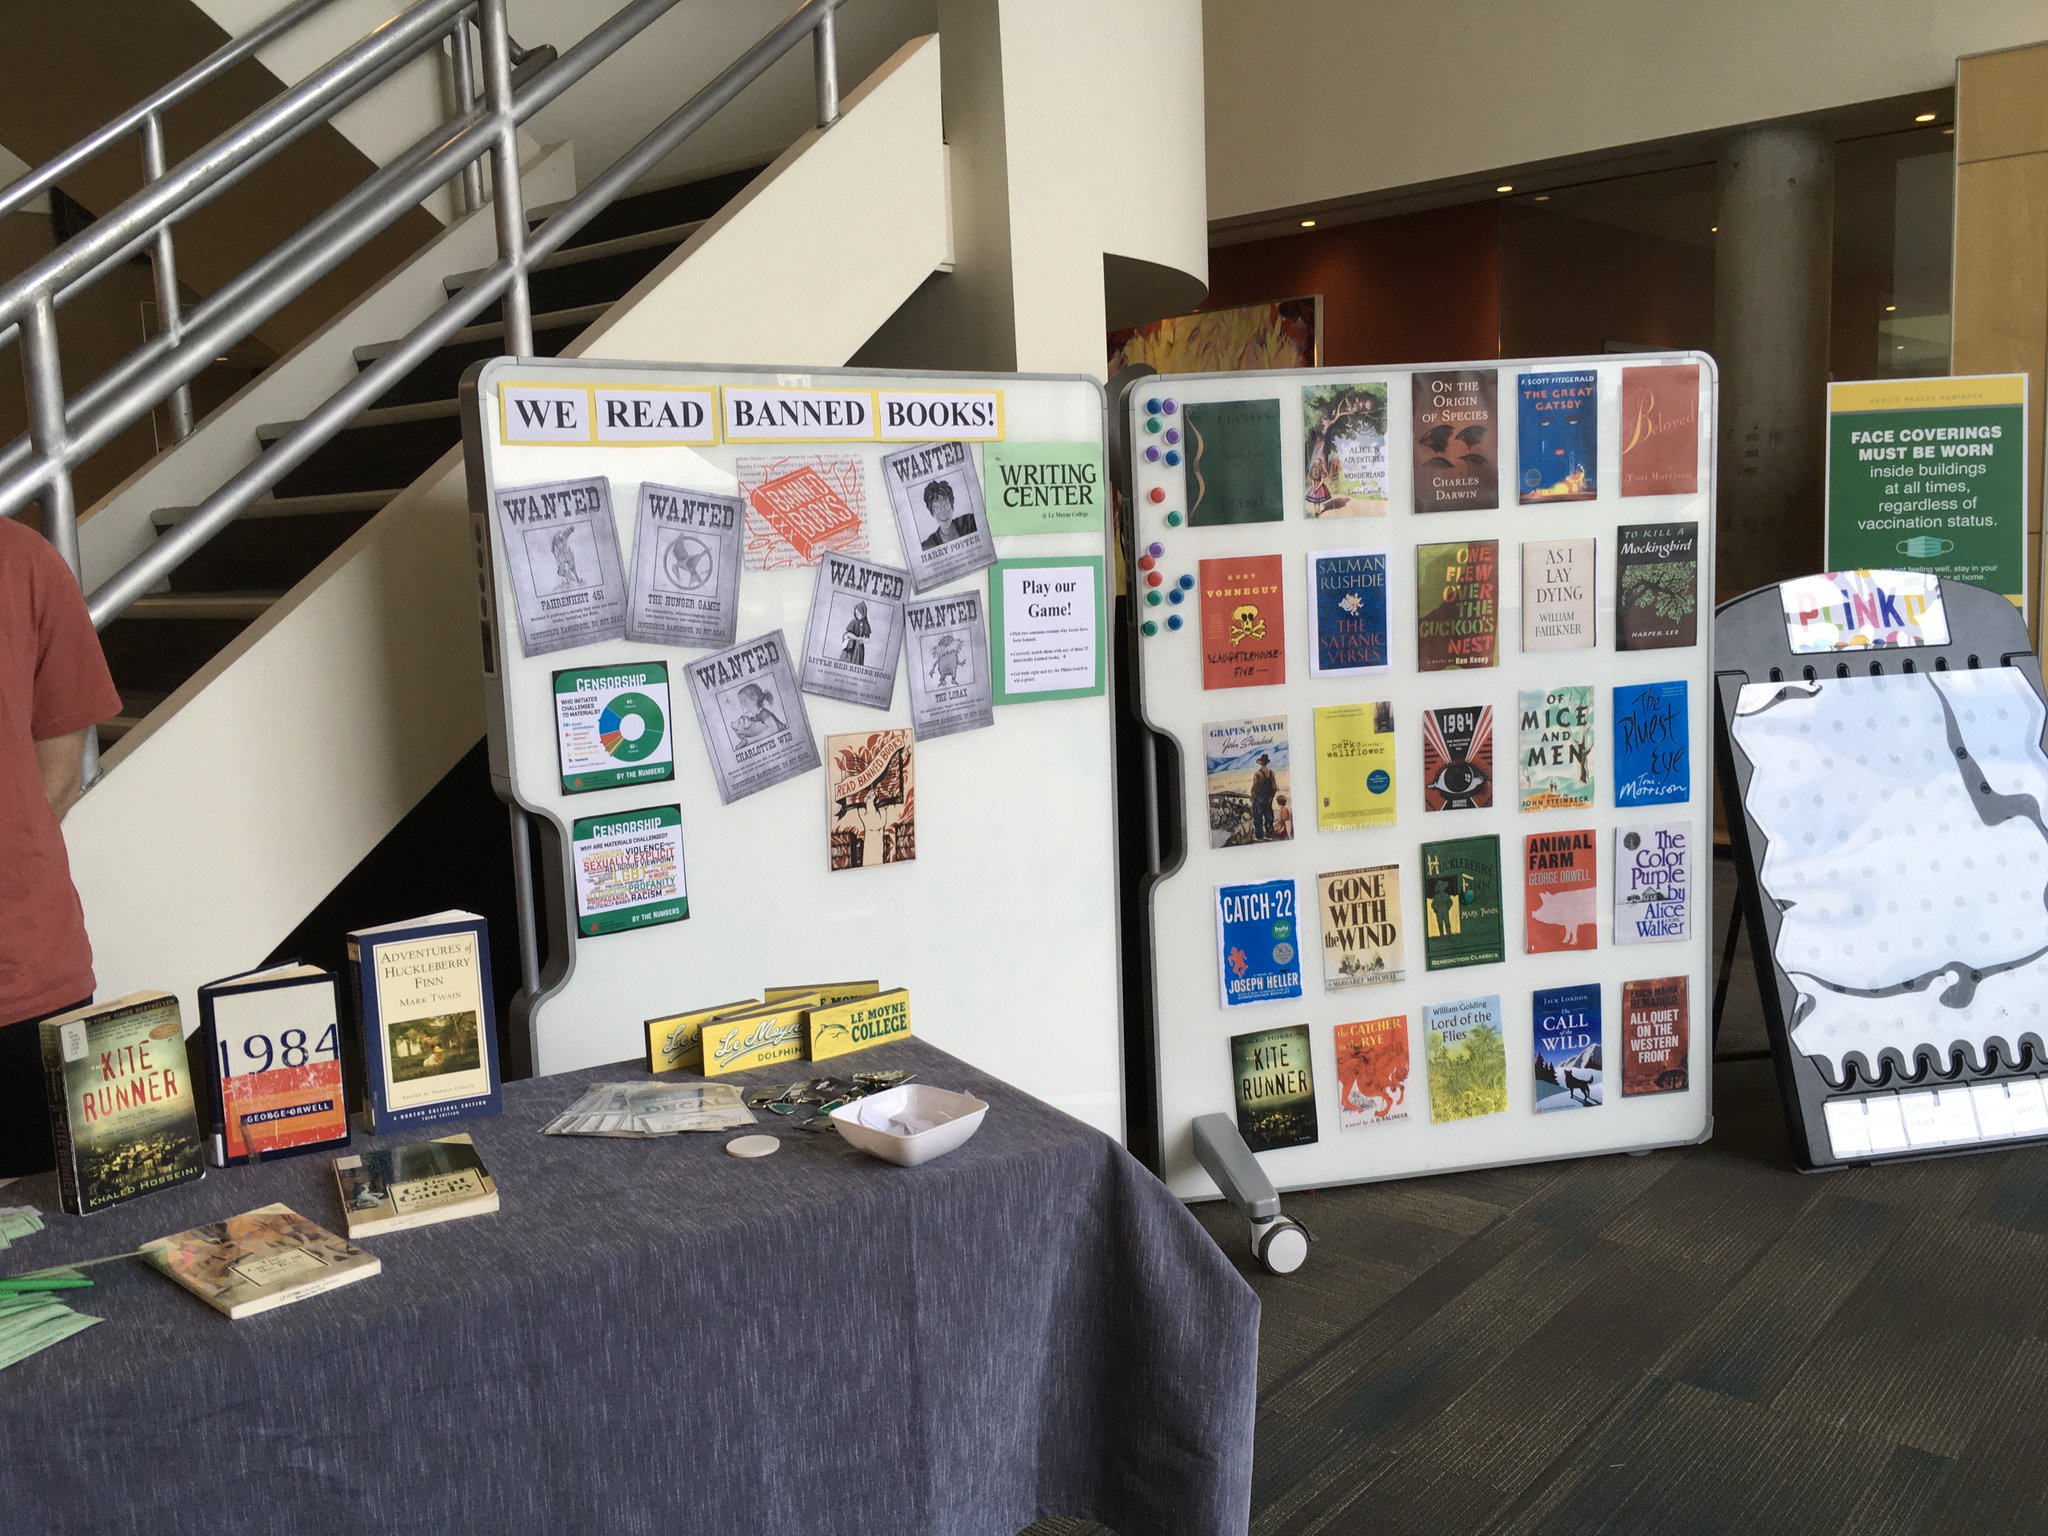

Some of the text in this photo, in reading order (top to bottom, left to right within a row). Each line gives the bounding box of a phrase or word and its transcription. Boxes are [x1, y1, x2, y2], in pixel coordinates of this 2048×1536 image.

[1457, 382, 1479, 391] THE
[1524, 387, 1593, 399] THE GREAT
[1535, 400, 1582, 410] GATSBY
[514, 400, 994, 428] WE READ BANNED BOOKS!
[1852, 426, 2002, 444] FACE COVERINGS
[1859, 444, 1993, 461] MUST BE WORN
[893, 442, 965, 482] WANTED
[1870, 462, 1986, 479] inside buildings
[1000, 464, 1096, 486] WRITING
[1344, 471, 1385, 480] WONDERLAND
[766, 474, 828, 512] BANNED
[1885, 481, 1970, 494] at all times,
[1003, 485, 1093, 508] CENTER
[503, 486, 601, 525] WANTED
[649, 494, 734, 530] WANTED
[1879, 497, 1977, 515] regardless of
[788, 495, 851, 537] BOOKS
[1858, 515, 1998, 530] vaccination status.
[1643, 529, 1671, 538] KILL
[921, 546, 948, 562] HARRY
[951, 536, 980, 552] POTTER
[1457, 547, 1491, 564] ONE
[1546, 549, 1572, 564] AS I
[1621, 539, 1693, 558] Mockingbird
[1318, 558, 1385, 575] SALMAN
[1446, 565, 1492, 582] FLEW
[1954, 565, 1997, 573] stay your
[830, 560, 904, 600] WANTED
[1321, 574, 1384, 590] RUSHDIE
[1547, 568, 1572, 583] LAY
[1022, 580, 1076, 597] Play our
[1207, 586, 1278, 598] VONNEGUT
[1443, 583, 1493, 602] OVER
[1537, 586, 1582, 603] DYING
[541, 590, 604, 611] FAHRENHEIT 451
[648, 594, 720, 611] THE HUNGER GAMES
[1458, 601, 1493, 617] THE
[908, 599, 977, 632] WANTED
[1028, 602, 1071, 618] Game!
[1539, 612, 1574, 622] WILLIAM
[1420, 618, 1494, 637] CUCKOO'S
[1536, 624, 1581, 637] FAULKNER
[1320, 632, 1385, 647] SATANIC
[1448, 635, 1494, 654] NEST
[696, 640, 779, 690] WANTED
[1327, 650, 1379, 663] VERSES
[935, 688, 968, 703] THE LORAX
[1546, 694, 1564, 704] OF
[1444, 713, 1472, 733] 1984
[1521, 706, 1588, 730] MICE
[1210, 722, 1284, 738] GRAPES WRATH
[1541, 731, 1570, 742] AND
[1327, 748, 1384, 758] wallflower
[1528, 744, 1584, 767] MEN
[837, 739, 902, 796] READ BANNED BOOKS
[1619, 781, 1687, 799] Morrison
[1530, 834, 1592, 853] ANIMAL
[1655, 829, 1685, 849] The
[626, 842, 664, 855] VIOLENCE
[584, 848, 674, 871] SEXUALLY EXPLICIT
[605, 856, 674, 873] RELIGIOUS VIEWPOINT
[1530, 852, 1573, 870] FARM
[1636, 849, 1685, 868] Color
[613, 865, 647, 882] LGBT
[1529, 869, 1590, 885] GEORGE ORWELL
[1631, 864, 1685, 890] Purple
[629, 877, 675, 892] PROFANITY
[1328, 874, 1385, 903] GONE
[631, 890, 662, 901] RACISM
[1224, 889, 1292, 923] CATCH-22
[1328, 900, 1387, 928] WITH
[1645, 903, 1684, 919] Alice
[1325, 923, 1396, 951] the WIND
[1636, 921, 1684, 937] Walker
[465, 942, 473, 954] of
[1229, 972, 1298, 993] JOSEPH HELLER
[851, 1002, 905, 1024] LE MOYNE
[1433, 1001, 1487, 1016] William Golding
[1630, 1009, 1679, 1025] ALL QUIET
[852, 1014, 907, 1042] COLLEGE
[1350, 1018, 1401, 1036] CATCHER
[1431, 1012, 1492, 1031] Lord of the
[1543, 1014, 1588, 1031] CALL
[1637, 1023, 1672, 1037] ON THE
[714, 1027, 740, 1058] Le
[744, 1017, 804, 1050] Moyn
[1362, 1035, 1384, 1047] RYE
[1442, 1030, 1467, 1043] Flies
[1542, 1034, 1590, 1051] WILD
[1631, 1035, 1678, 1050] WESTERN
[220, 1024, 339, 1078] 1984
[757, 1045, 802, 1062] DOLPHIN
[1254, 1044, 1289, 1070] KITE
[1639, 1050, 1671, 1063] FRONT
[100, 1040, 152, 1081] KITE
[1243, 1070, 1308, 1100] RUNNER
[83, 1069, 178, 1123] RUNNER
[247, 1102, 329, 1124] GEORGE ORWELL
